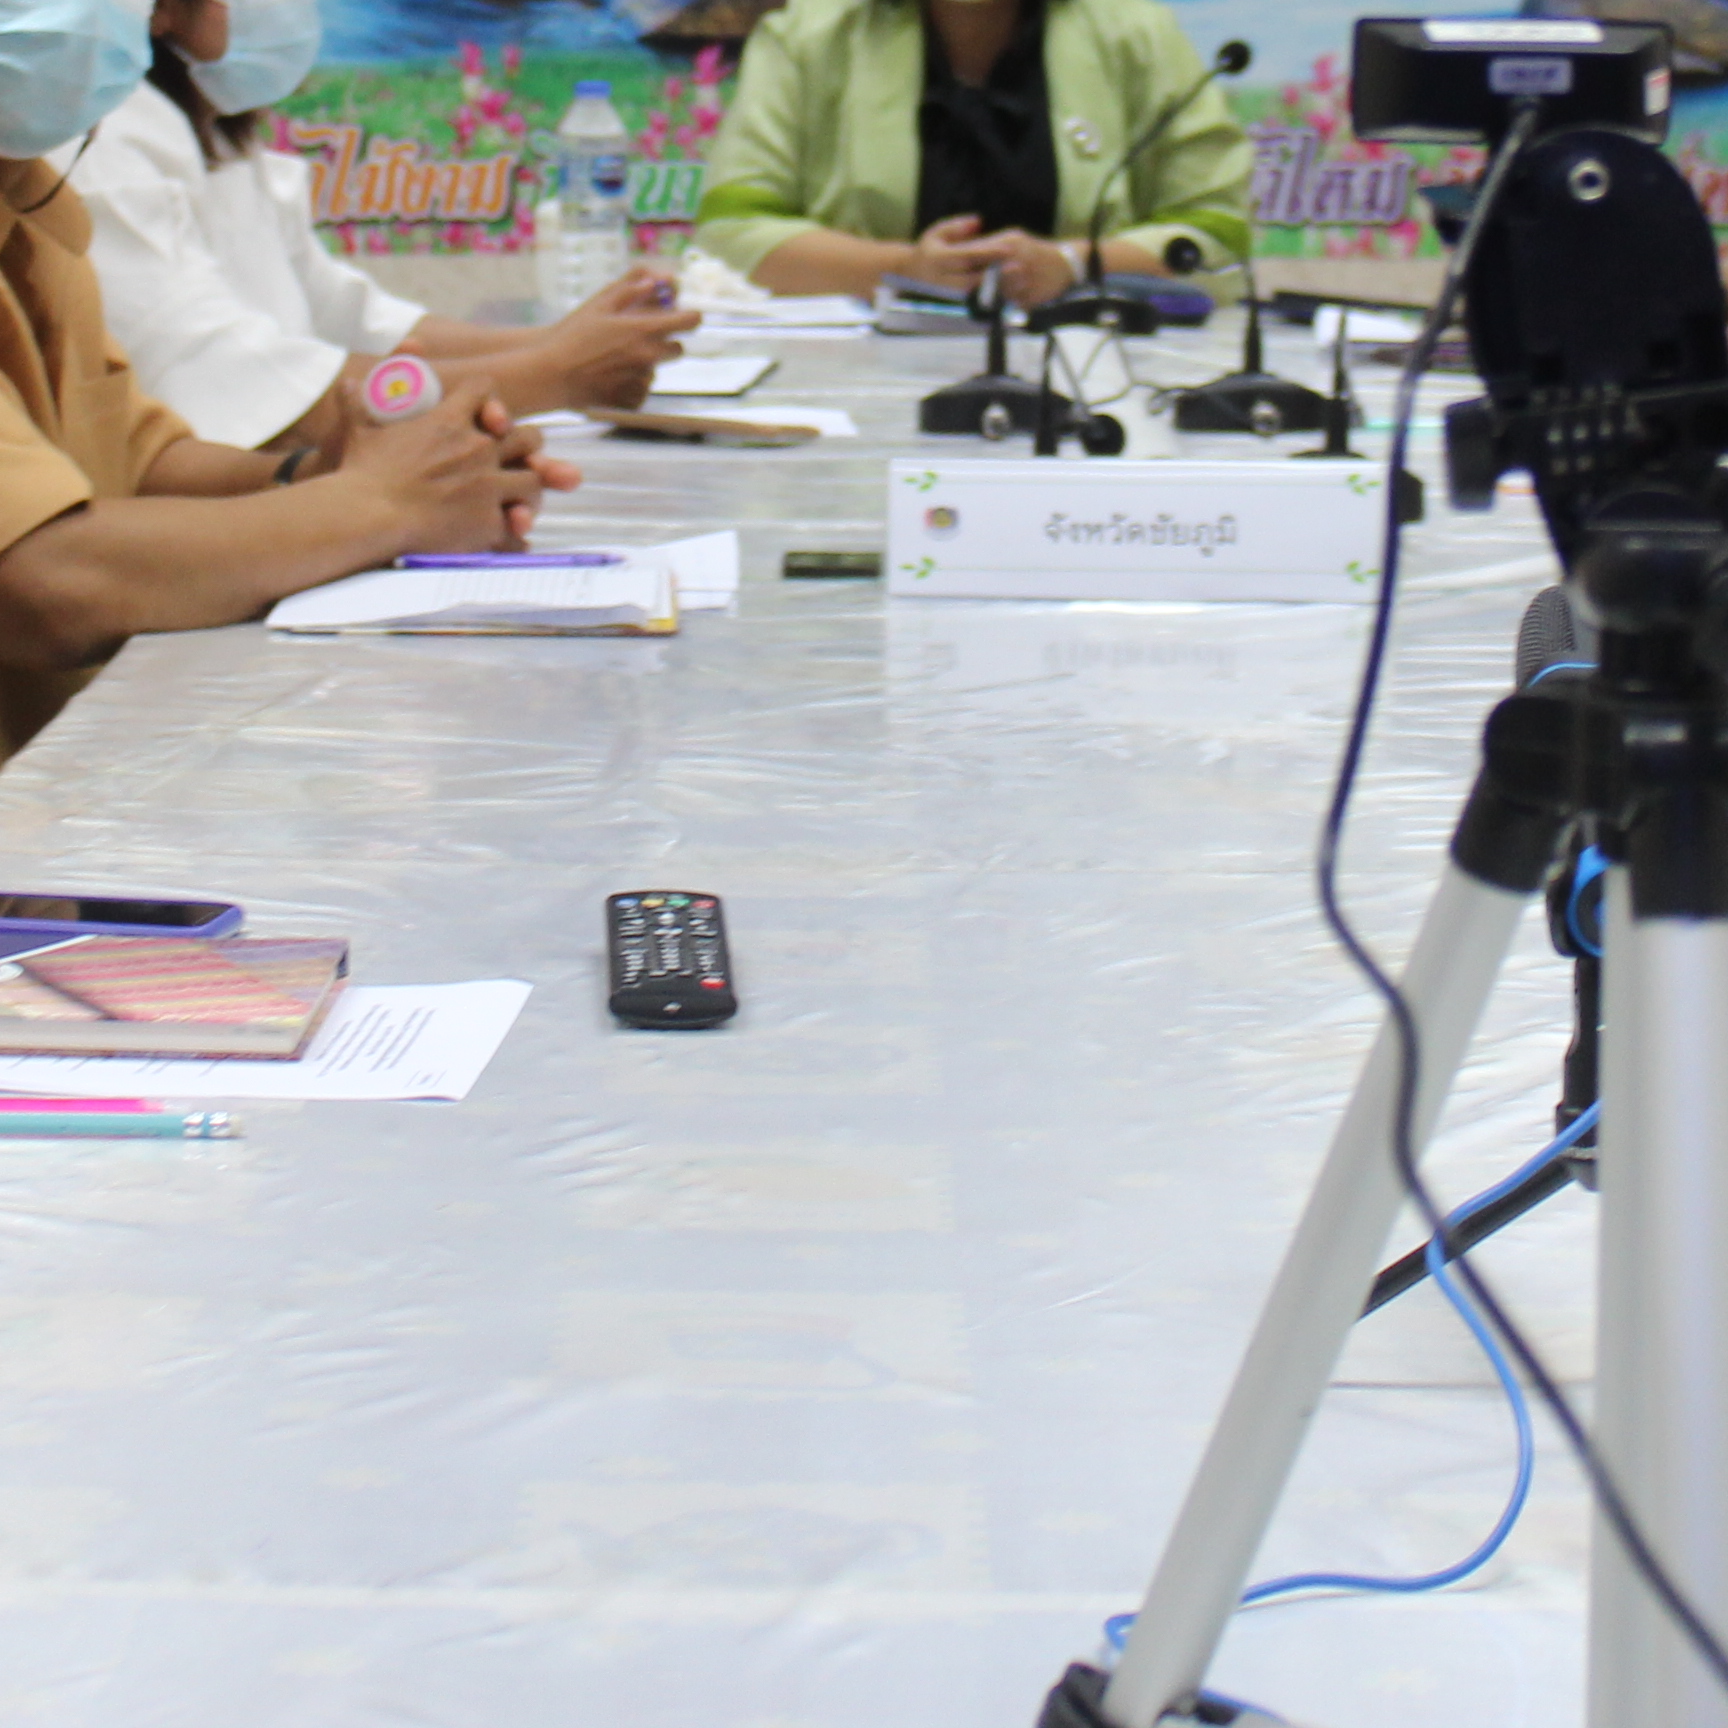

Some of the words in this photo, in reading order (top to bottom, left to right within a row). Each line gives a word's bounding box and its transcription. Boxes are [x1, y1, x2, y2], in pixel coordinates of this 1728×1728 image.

[1044, 512, 1239, 558] จังหวัดชัยภูมิ
